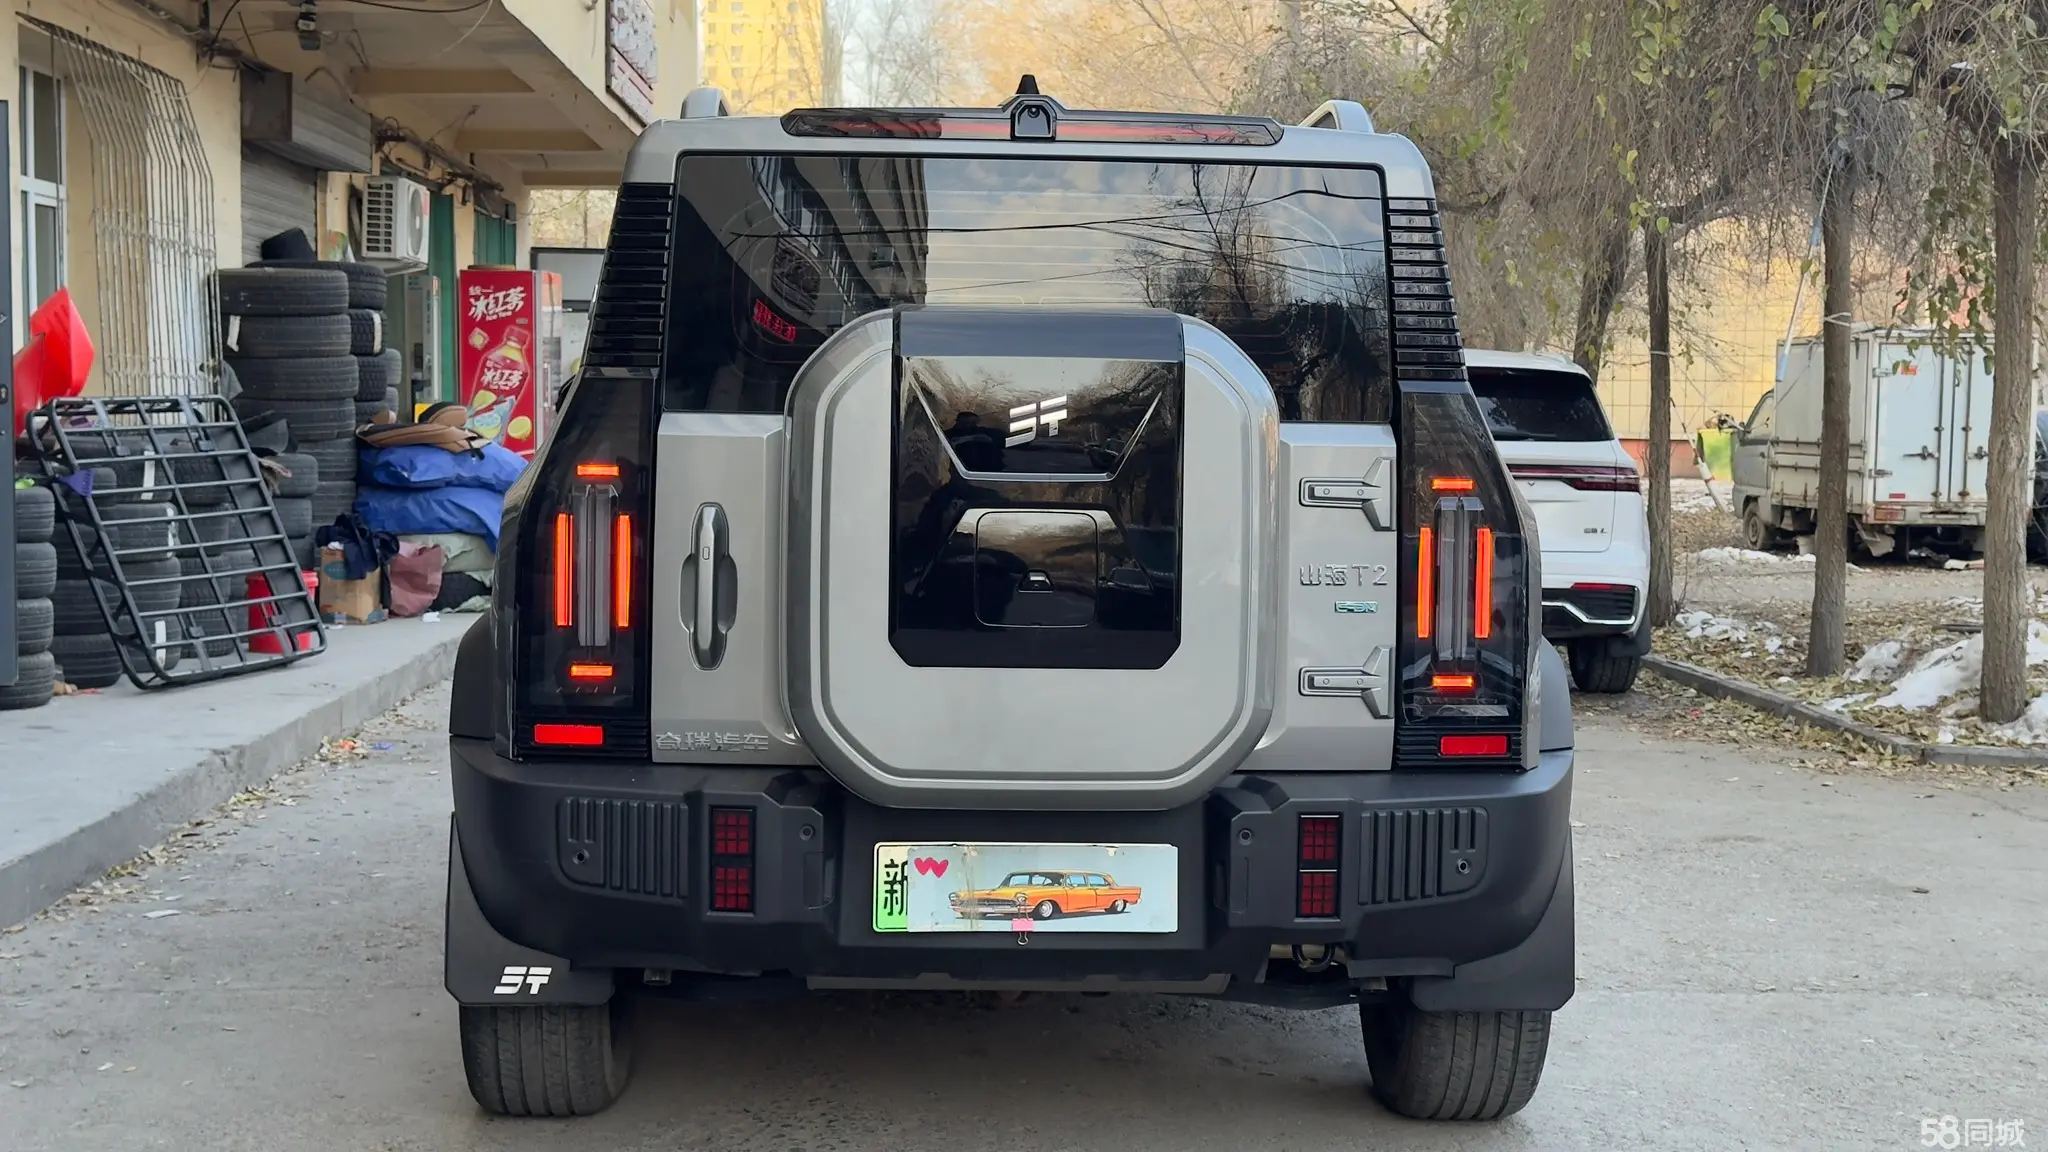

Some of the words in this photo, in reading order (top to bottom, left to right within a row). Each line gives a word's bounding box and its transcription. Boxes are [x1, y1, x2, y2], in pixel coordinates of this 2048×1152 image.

[468, 286, 527, 322] 冰红茶
[656, 731, 769, 752] 奇瑞汽车
